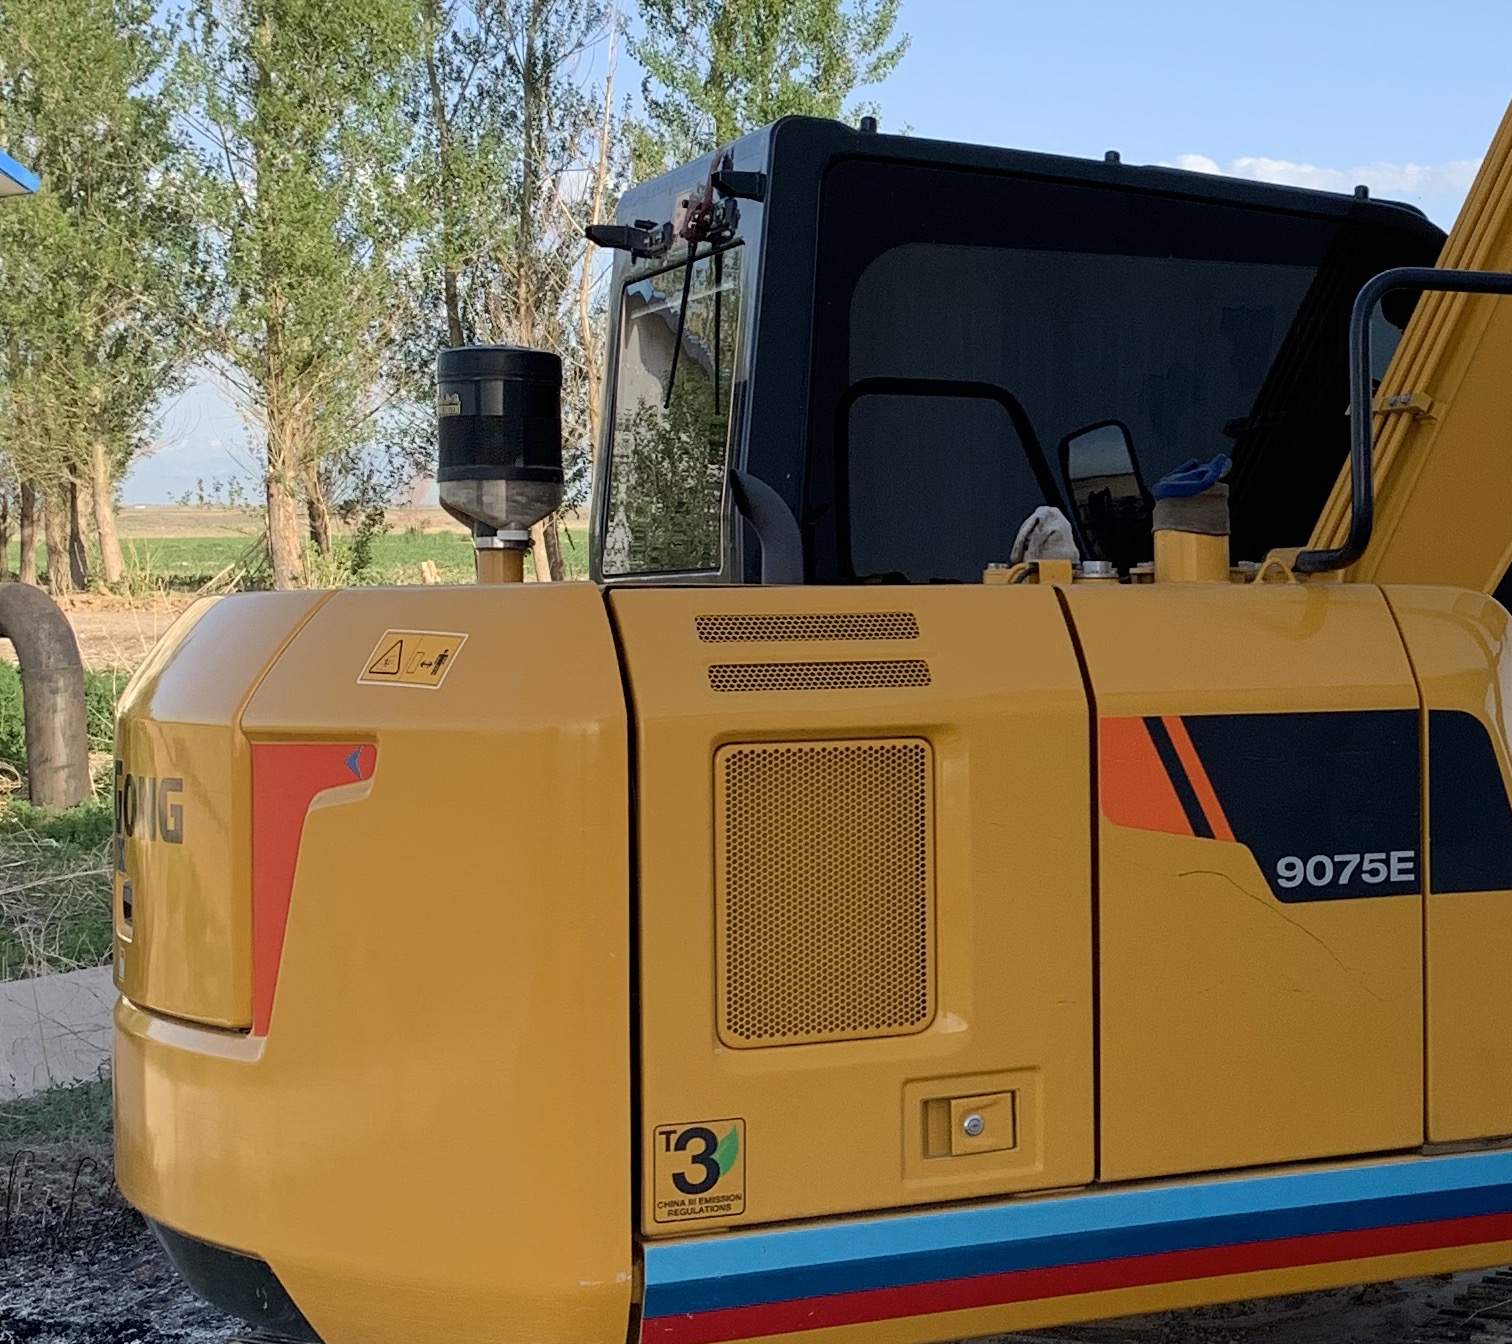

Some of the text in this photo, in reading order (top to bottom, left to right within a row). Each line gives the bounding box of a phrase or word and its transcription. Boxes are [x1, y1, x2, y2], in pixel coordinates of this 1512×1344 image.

[1276, 851, 1415, 888] 9075E
[657, 1199, 686, 1209] CHINA
[699, 1194, 742, 1205] EMISSION
[667, 1204, 732, 1216] REGULATIONS
